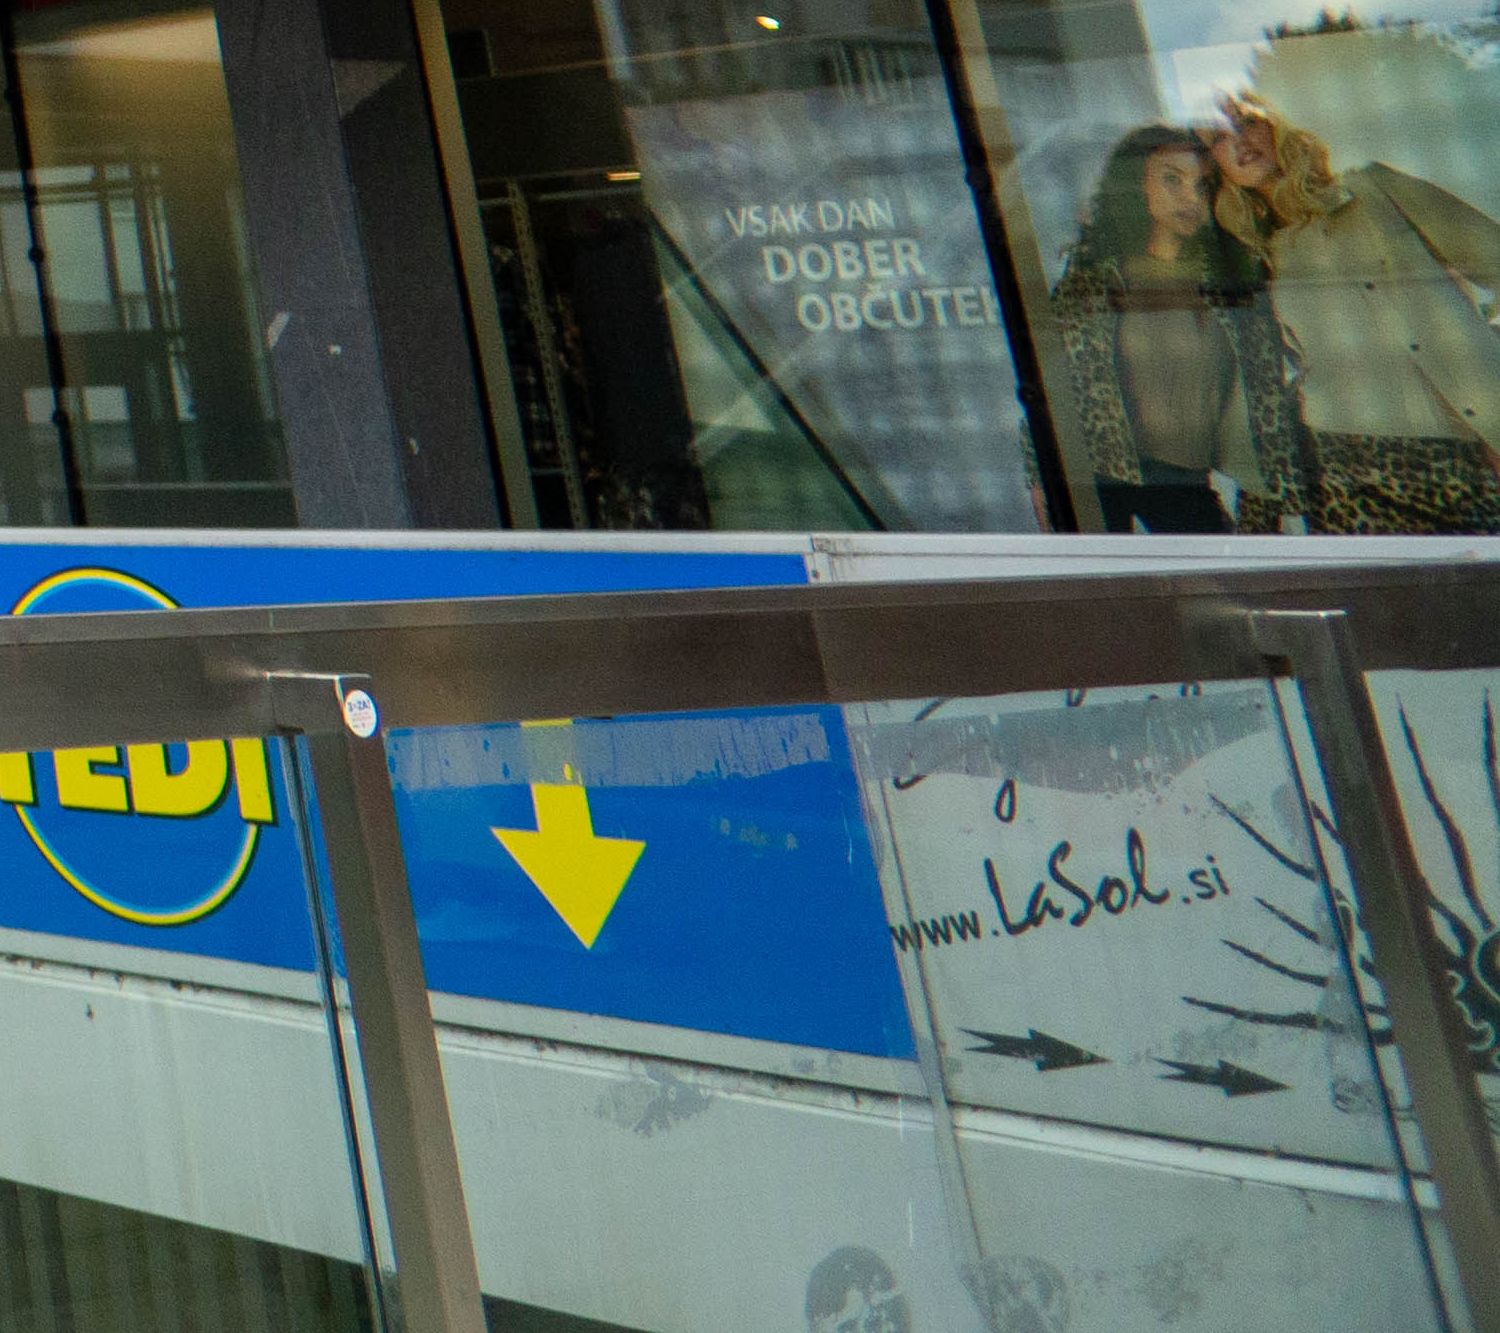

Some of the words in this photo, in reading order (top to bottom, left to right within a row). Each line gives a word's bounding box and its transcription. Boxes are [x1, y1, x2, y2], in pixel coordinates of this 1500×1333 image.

[724, 202, 812, 237] VSAK
[817, 197, 896, 232] DAN
[762, 238, 926, 283] DOBER
[890, 827, 1230, 952] www.LaSol.si
